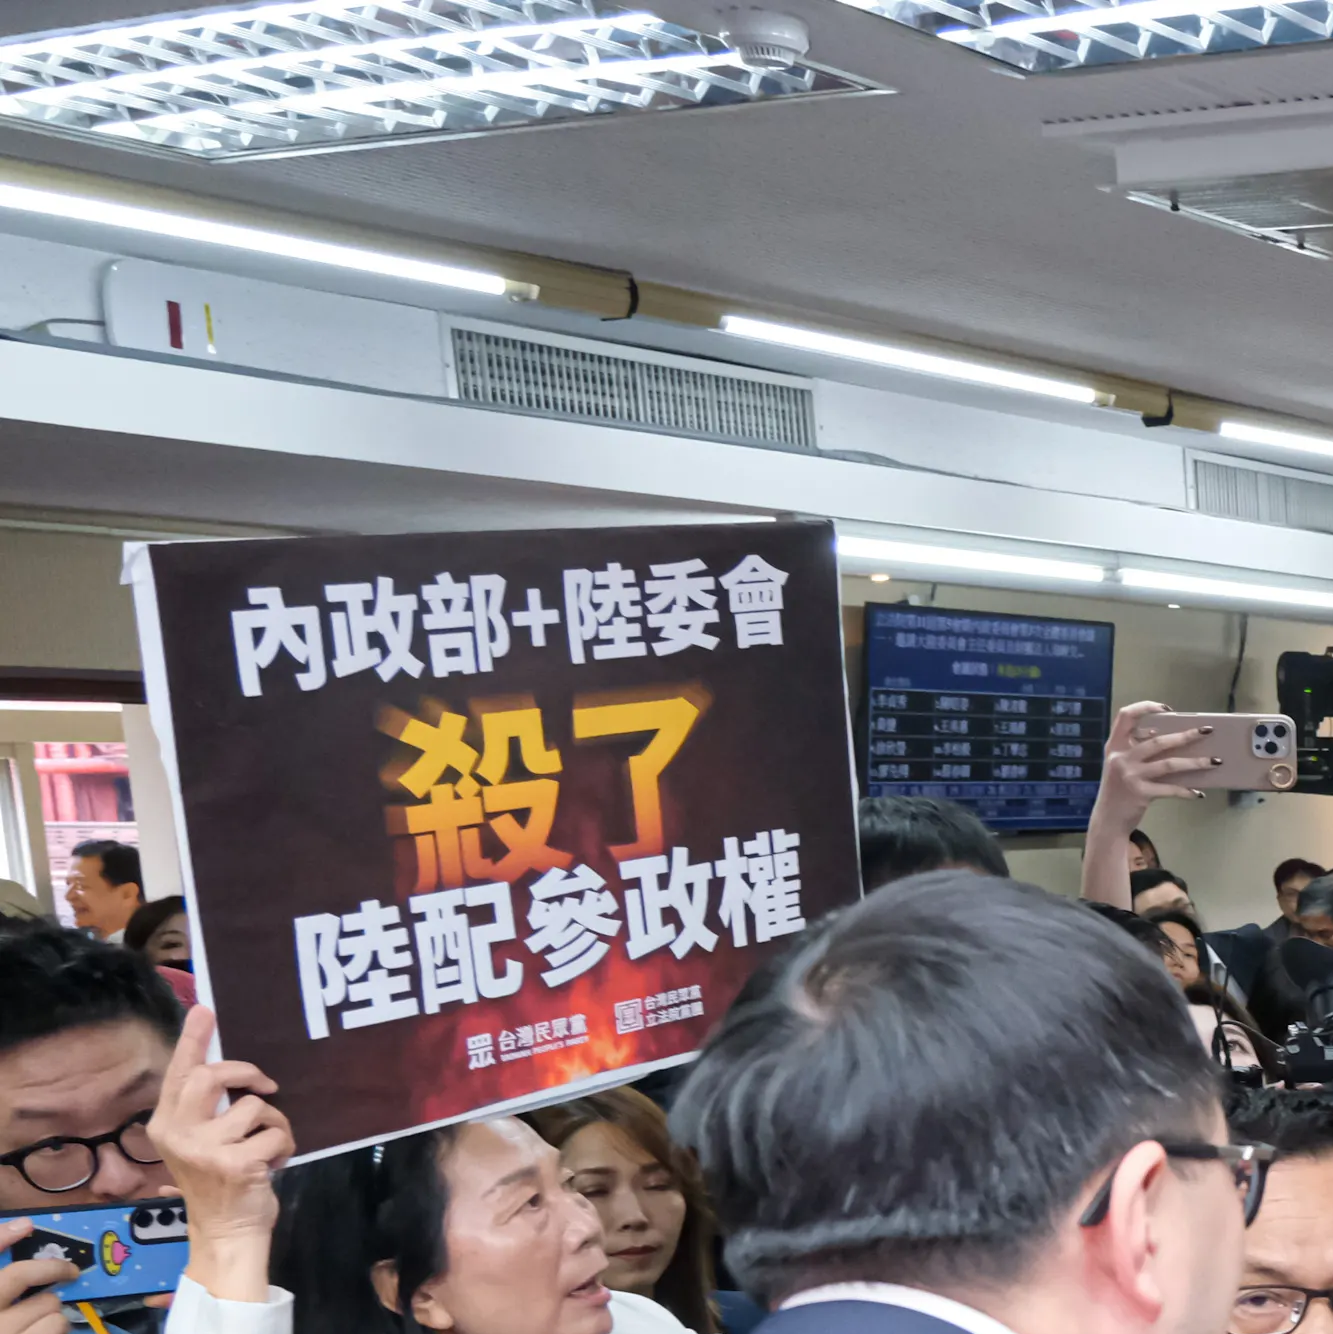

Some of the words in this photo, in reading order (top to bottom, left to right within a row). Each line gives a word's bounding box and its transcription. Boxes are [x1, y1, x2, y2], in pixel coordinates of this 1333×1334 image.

[230, 553, 790, 698] 內政部+陸委會
[397, 695, 702, 885] 殺了
[293, 828, 806, 1040] 陸配參政權
[498, 1013, 588, 1052] 台灣民眾黨
